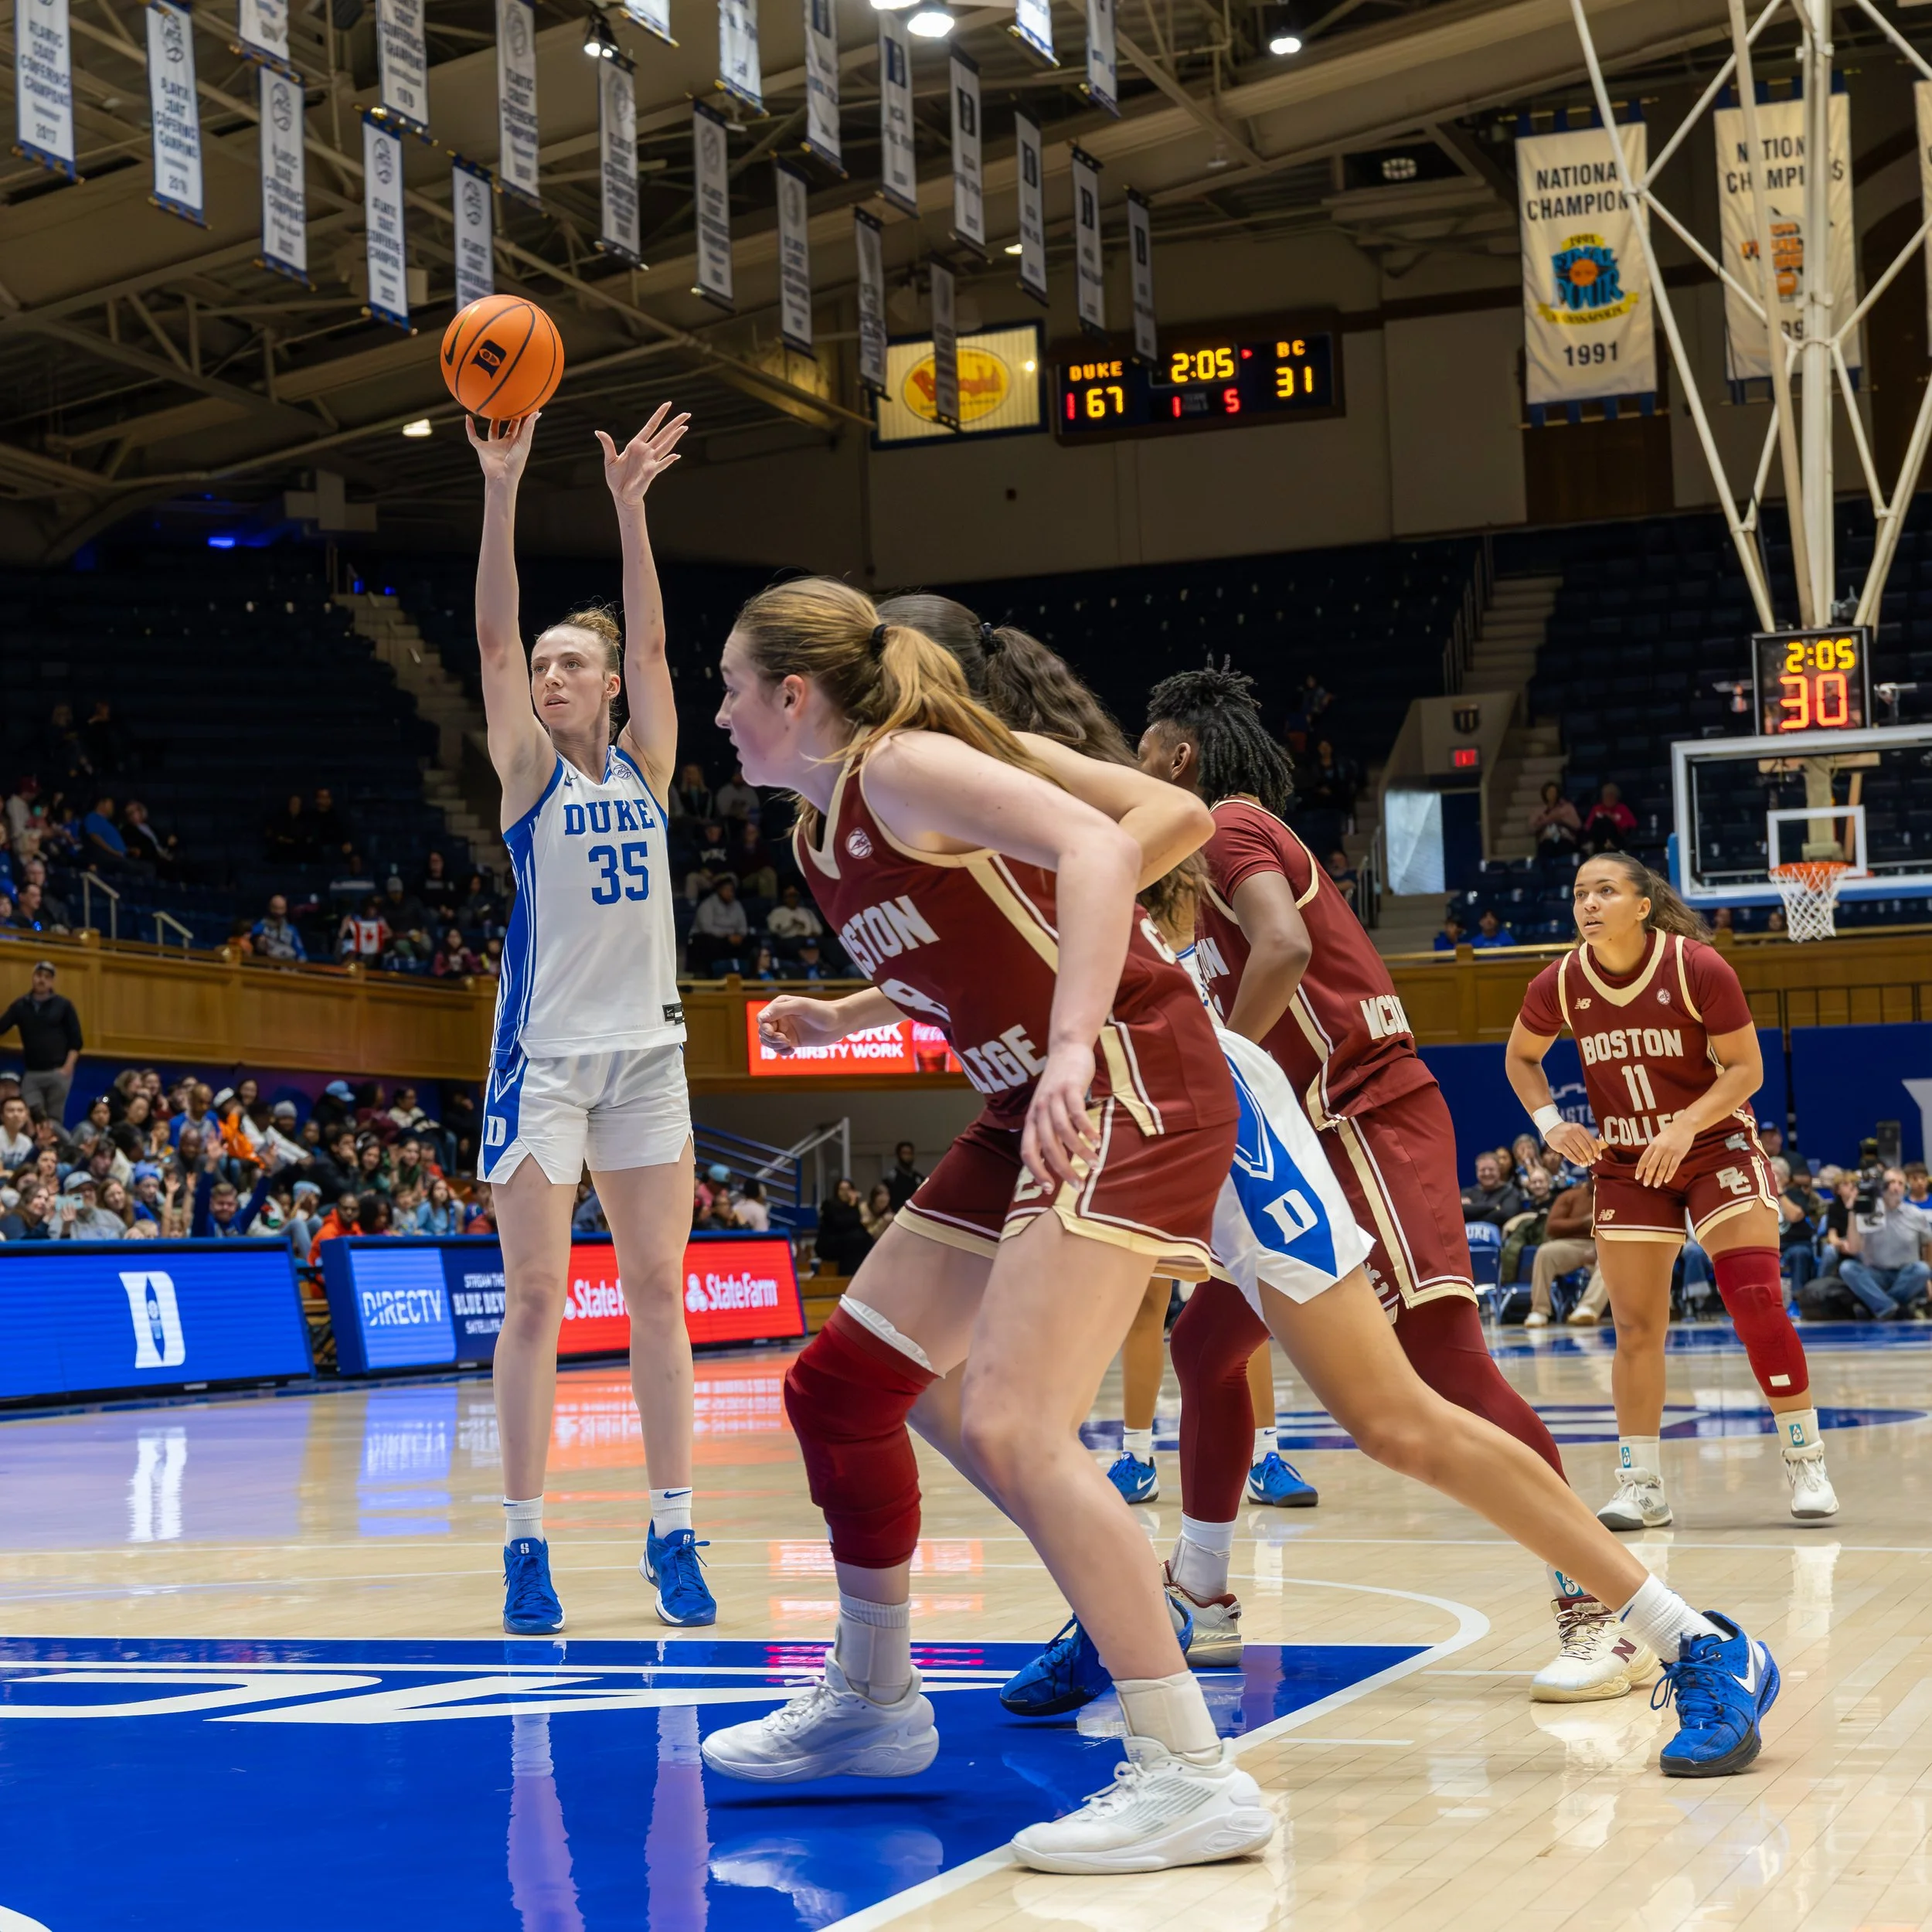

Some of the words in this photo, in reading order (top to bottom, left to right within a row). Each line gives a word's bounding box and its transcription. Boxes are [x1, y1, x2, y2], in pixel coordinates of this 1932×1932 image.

[1536, 161, 1617, 191] NATIONA
[1526, 189, 1640, 222] CHAMPION
[1171, 347, 1234, 383] 2:05
[1277, 339, 1306, 358] BC
[1563, 340, 1619, 367] 1991
[1070, 360, 1123, 382] DUKE
[1276, 366, 1313, 398] 31
[1087, 386, 1124, 418] 67
[1786, 638, 1855, 673] 2:05
[1780, 672, 1848, 730] 30
[563, 798, 656, 836] DUKE
[588, 841, 650, 906] 35
[851, 1043, 904, 1059] WORK
[1580, 1028, 1684, 1066] BOSTON
[1621, 1064, 1657, 1111] 11
[485, 1115, 507, 1147] D
[1604, 1109, 1685, 1146] COLLE
[1262, 1189, 1318, 1244] D
[118, 1270, 186, 1369] D
[362, 1289, 442, 1327] DIRECTV
[1611, 1637, 1637, 1663] N
